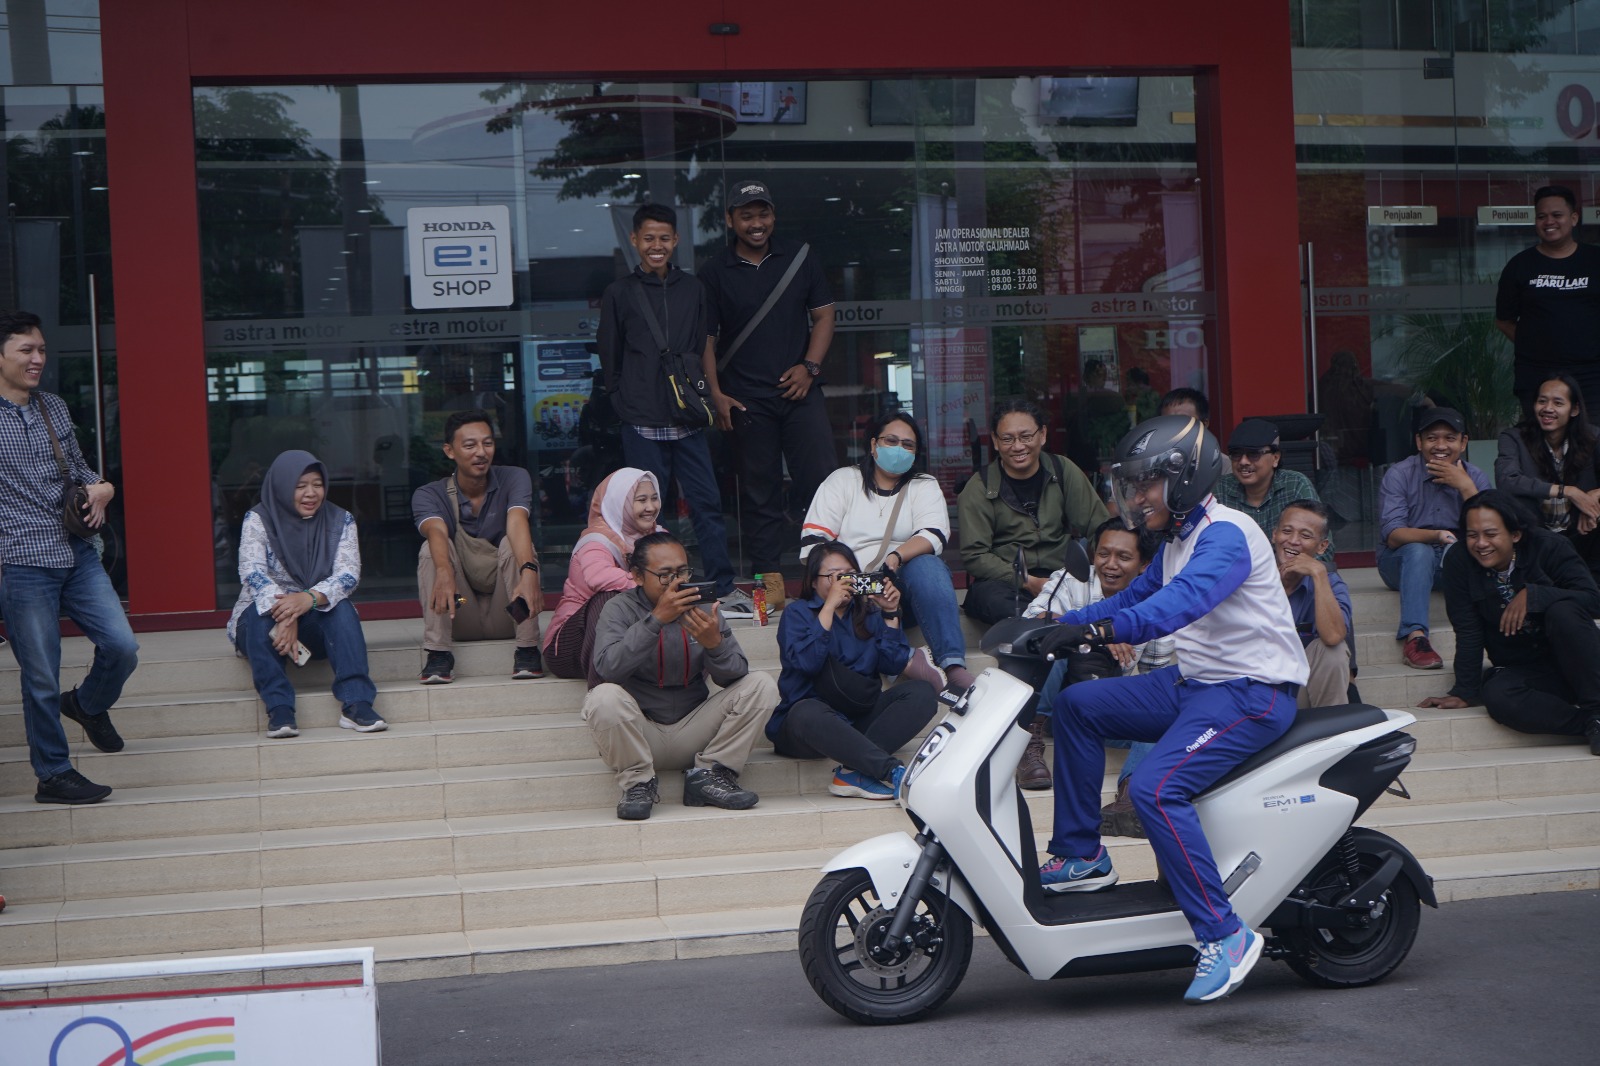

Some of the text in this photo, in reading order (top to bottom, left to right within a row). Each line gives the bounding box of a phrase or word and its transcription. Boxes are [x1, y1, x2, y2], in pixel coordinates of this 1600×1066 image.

[1383, 210, 1423, 222] Penjualan
[1492, 209, 1529, 221] Penjualan
[423, 222, 496, 232] HONDA
[935, 227, 1030, 240] JAM OPERASIONAL DEALER
[935, 240, 1030, 253] ASTRA MOTOR GAJAHMADA
[935, 256, 984, 265] SHOWROOM
[433, 280, 491, 296] SHOP
[1536, 278, 1564, 288] BARU
[1566, 277, 1589, 287] LAKI
[996, 300, 1050, 317] motor
[1091, 295, 1198, 313] astra motor
[223, 322, 345, 341] astra motor
[389, 316, 508, 336] astra motor
[947, 345, 985, 354] PENTING
[1264, 798, 1298, 808] EM1
